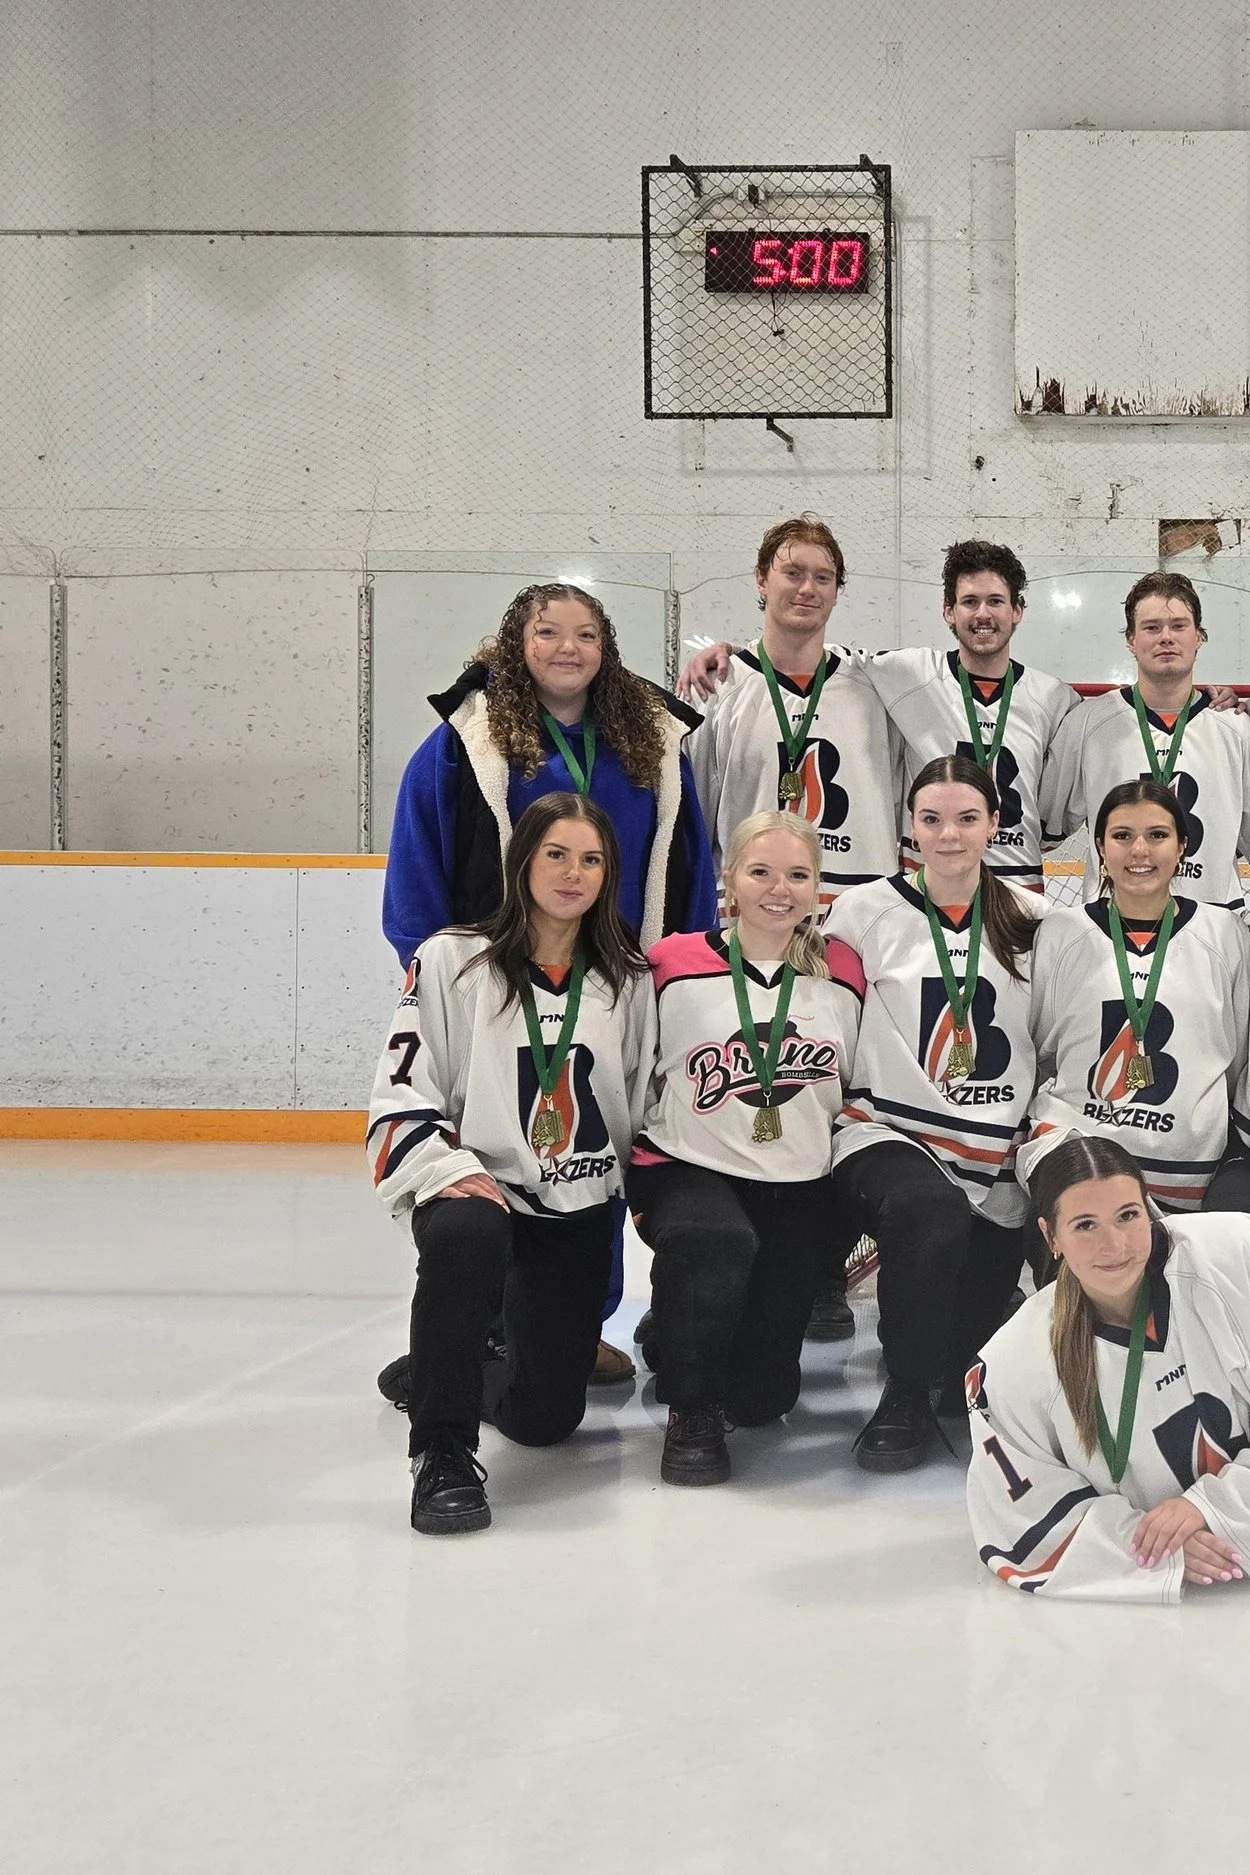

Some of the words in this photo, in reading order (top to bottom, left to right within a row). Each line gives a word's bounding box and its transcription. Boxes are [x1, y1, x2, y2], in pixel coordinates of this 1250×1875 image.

[816, 833, 852, 853] ZERS
[387, 1031, 422, 1088] 7
[950, 1084, 1015, 1106] ZERS
[984, 1435, 1034, 1503] 1
